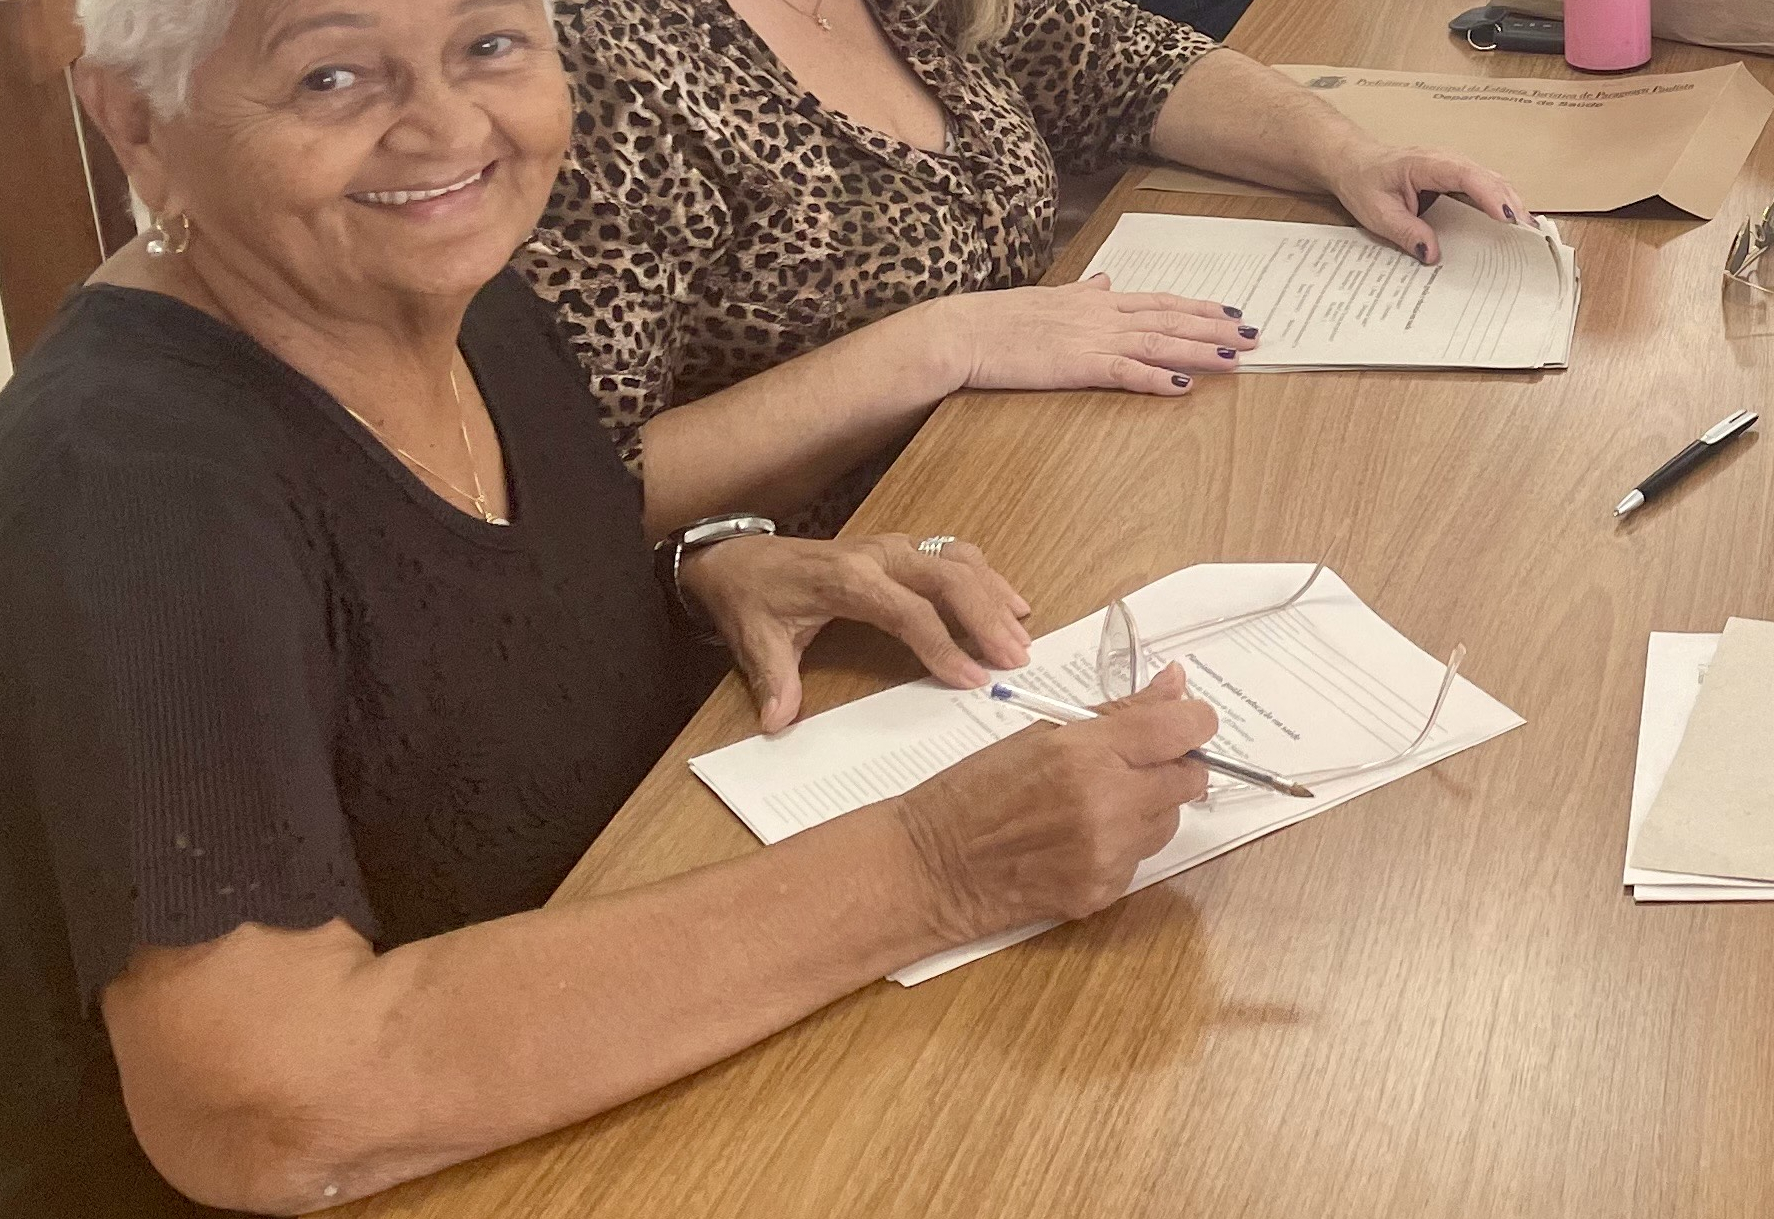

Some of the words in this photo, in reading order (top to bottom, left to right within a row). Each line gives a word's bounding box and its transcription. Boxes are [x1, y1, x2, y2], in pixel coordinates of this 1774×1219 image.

[1415, 81, 1467, 92] Municipal
[1432, 93, 1533, 104] Departamento
[1536, 99, 1554, 107] de
[1558, 99, 1604, 108] Saúde
